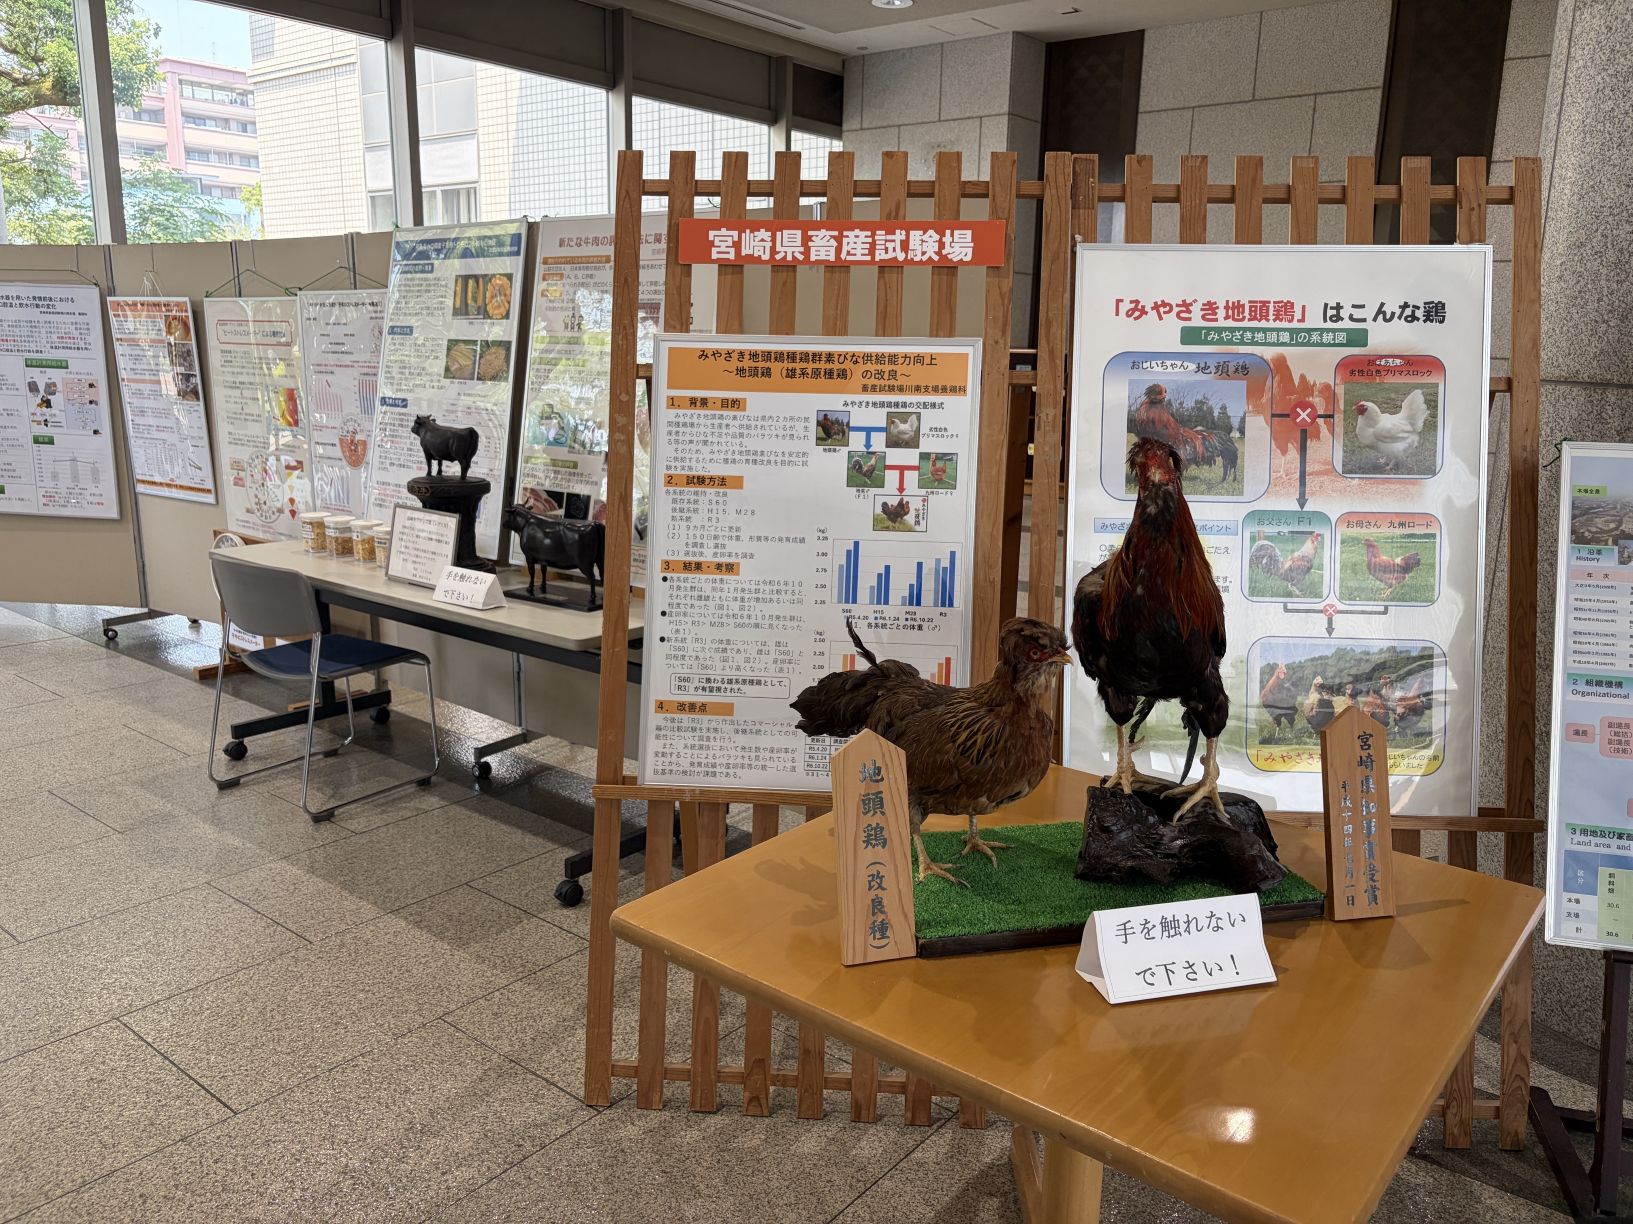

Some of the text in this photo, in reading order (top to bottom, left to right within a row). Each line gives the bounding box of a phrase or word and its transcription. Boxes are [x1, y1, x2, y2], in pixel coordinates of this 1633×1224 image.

[708, 227, 974, 262] 宮崎県畜産試験場
[1200, 330, 1347, 345] 「みやざき地頭鶏」の系統図
[698, 349, 938, 367] みやざき地頭鶏種鶏群素びな供給能力向上
[1130, 360, 1250, 377] おじいちゃん 地頭鶏
[861, 384, 968, 395] 畜産試験場川南支場養鶏科
[842, 400, 945, 410] みやざき地頭鶏種鶏の交配様式
[1256, 517, 1312, 526] お父さん F1
[1346, 520, 1433, 529] お母さん 九州ロード
[446, 570, 487, 585] 手を触れない
[1571, 688, 1630, 700] Organizational
[1570, 838, 1592, 847] Land
[1616, 843, 1632, 851] and
[1115, 910, 1246, 944] 手を触れない
[1135, 954, 1240, 986] で下さい！
